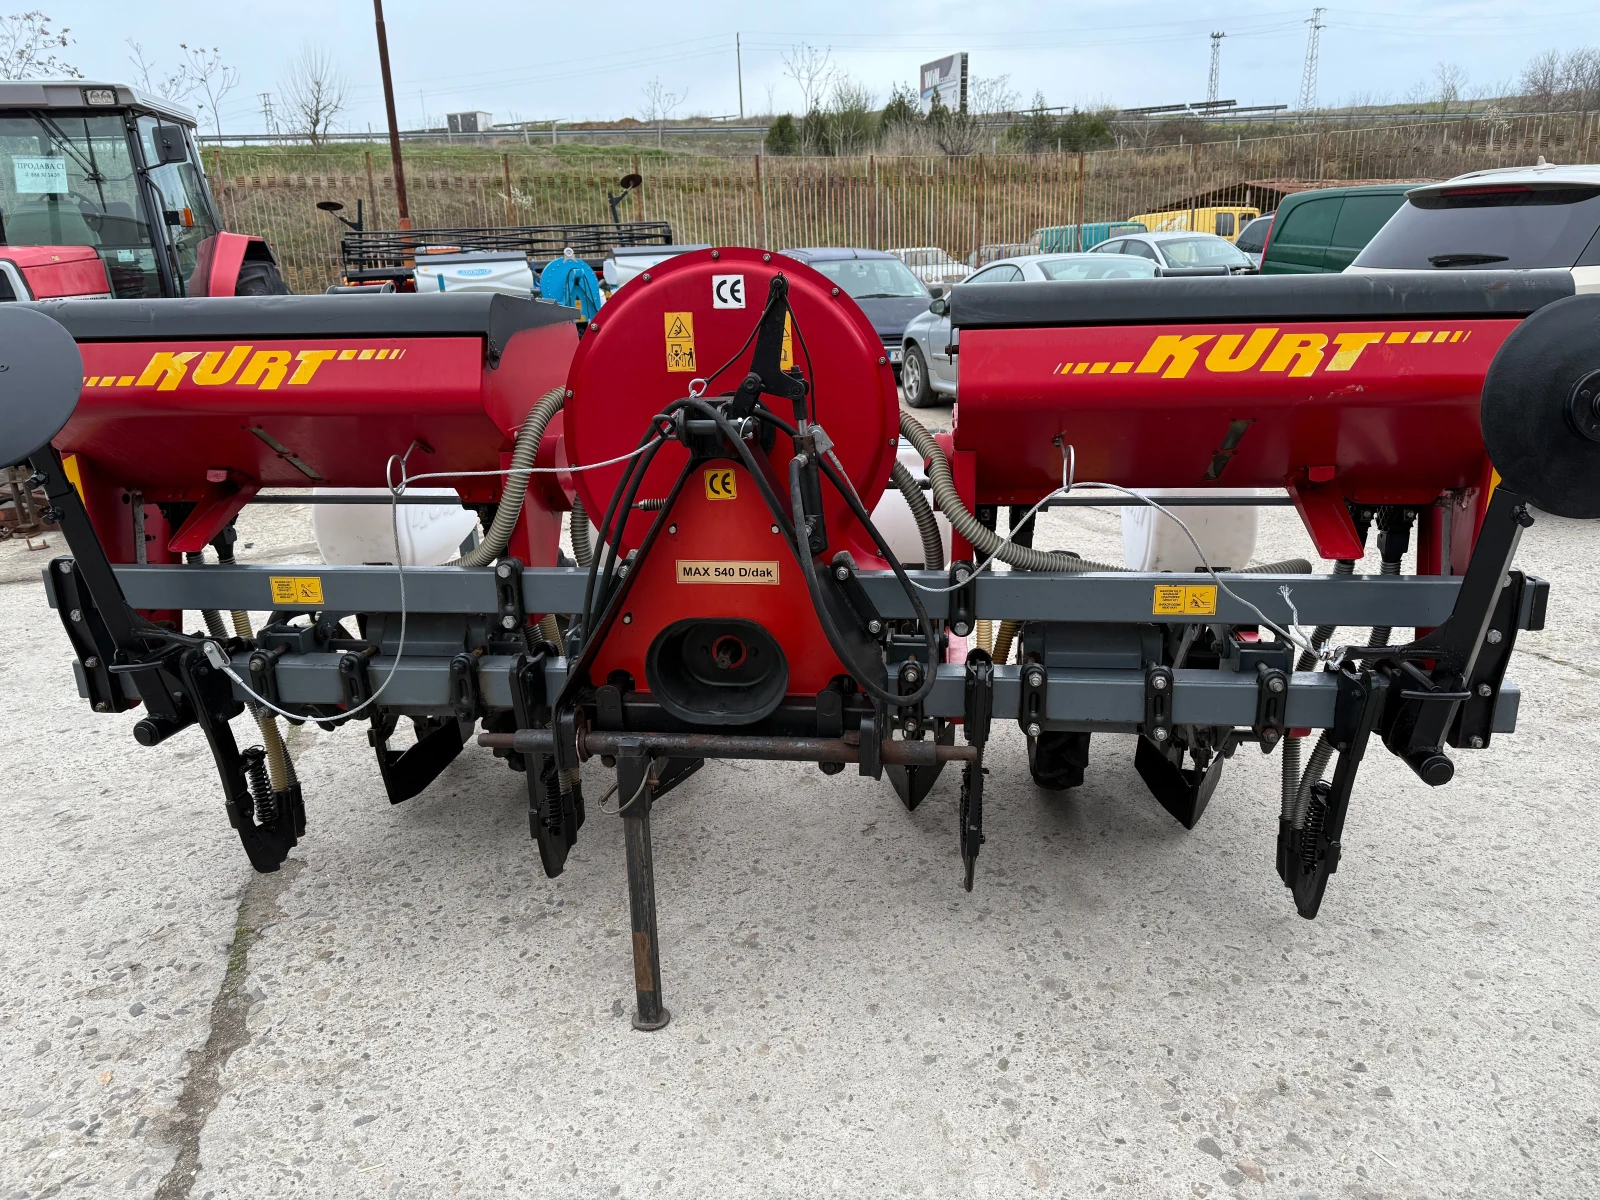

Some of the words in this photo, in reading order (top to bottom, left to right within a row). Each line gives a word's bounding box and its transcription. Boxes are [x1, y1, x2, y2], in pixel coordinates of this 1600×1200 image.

[17, 162, 56, 170] ПРОДАВА
[716, 279, 742, 304] CE
[1133, 327, 1386, 379] KURT
[135, 345, 338, 391] KURT
[709, 472, 732, 495] CE
[682, 567, 711, 577] MAX
[714, 567, 735, 577] 540
[738, 567, 773, 578] D/dak
